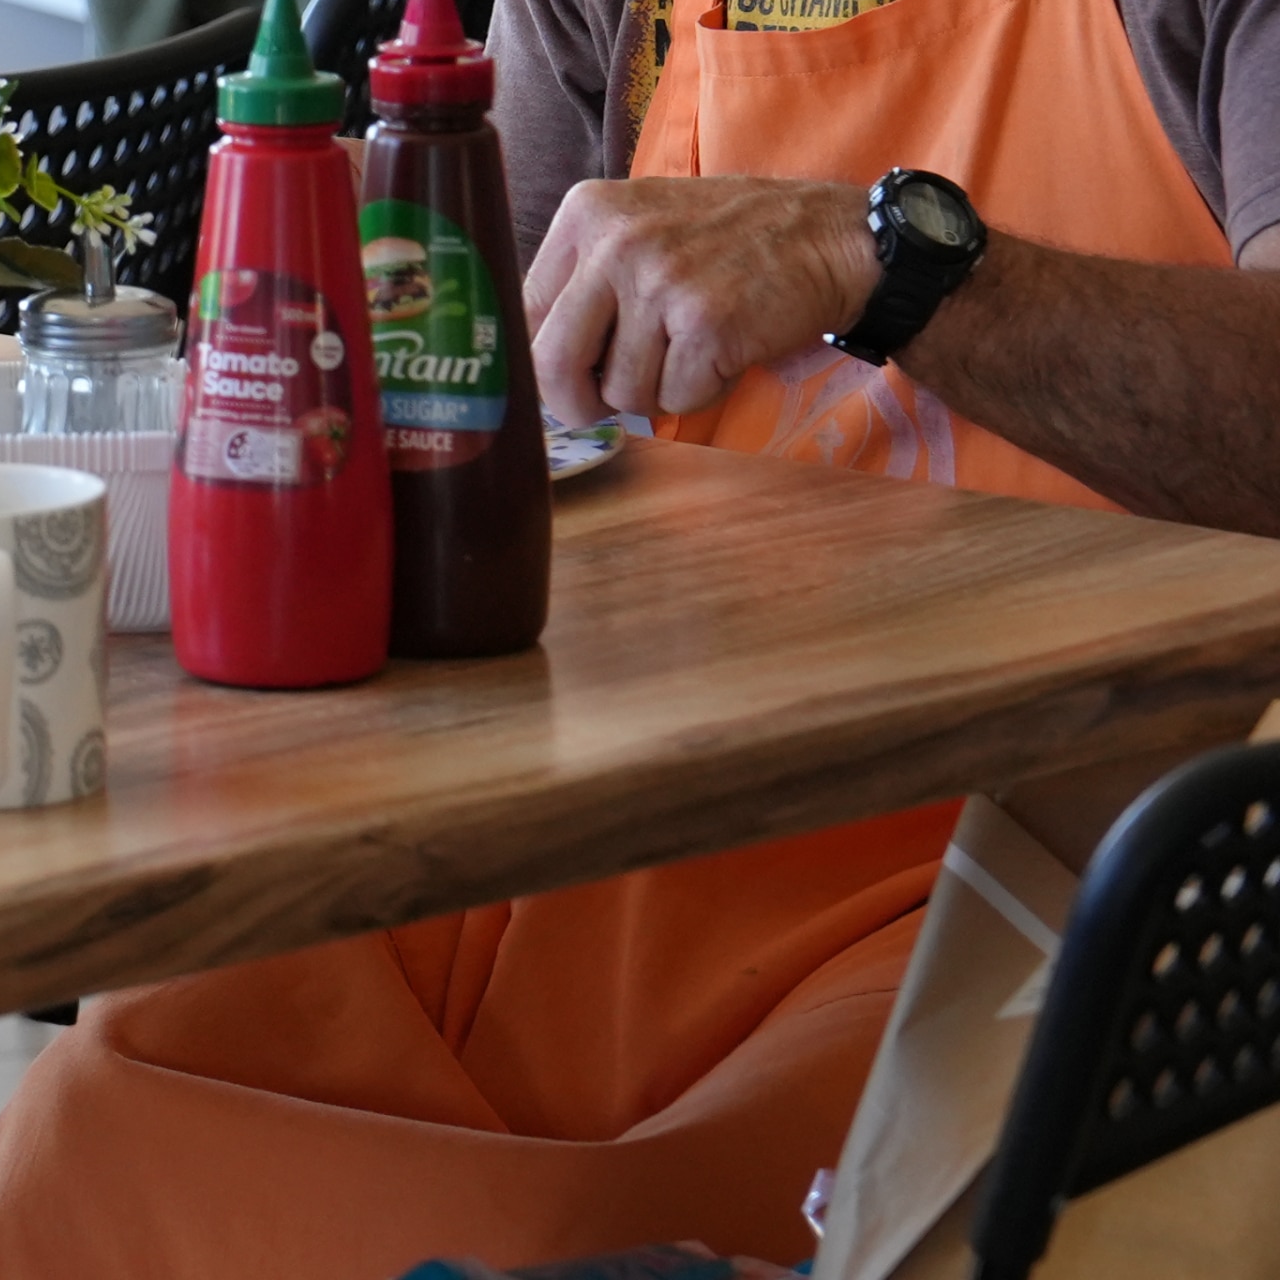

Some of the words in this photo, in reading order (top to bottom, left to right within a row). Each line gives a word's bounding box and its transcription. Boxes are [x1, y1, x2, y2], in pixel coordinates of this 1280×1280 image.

[198, 342, 300, 378] Tomato
[203, 370, 285, 402] Sauce
[398, 429, 453, 452] SAUCE
